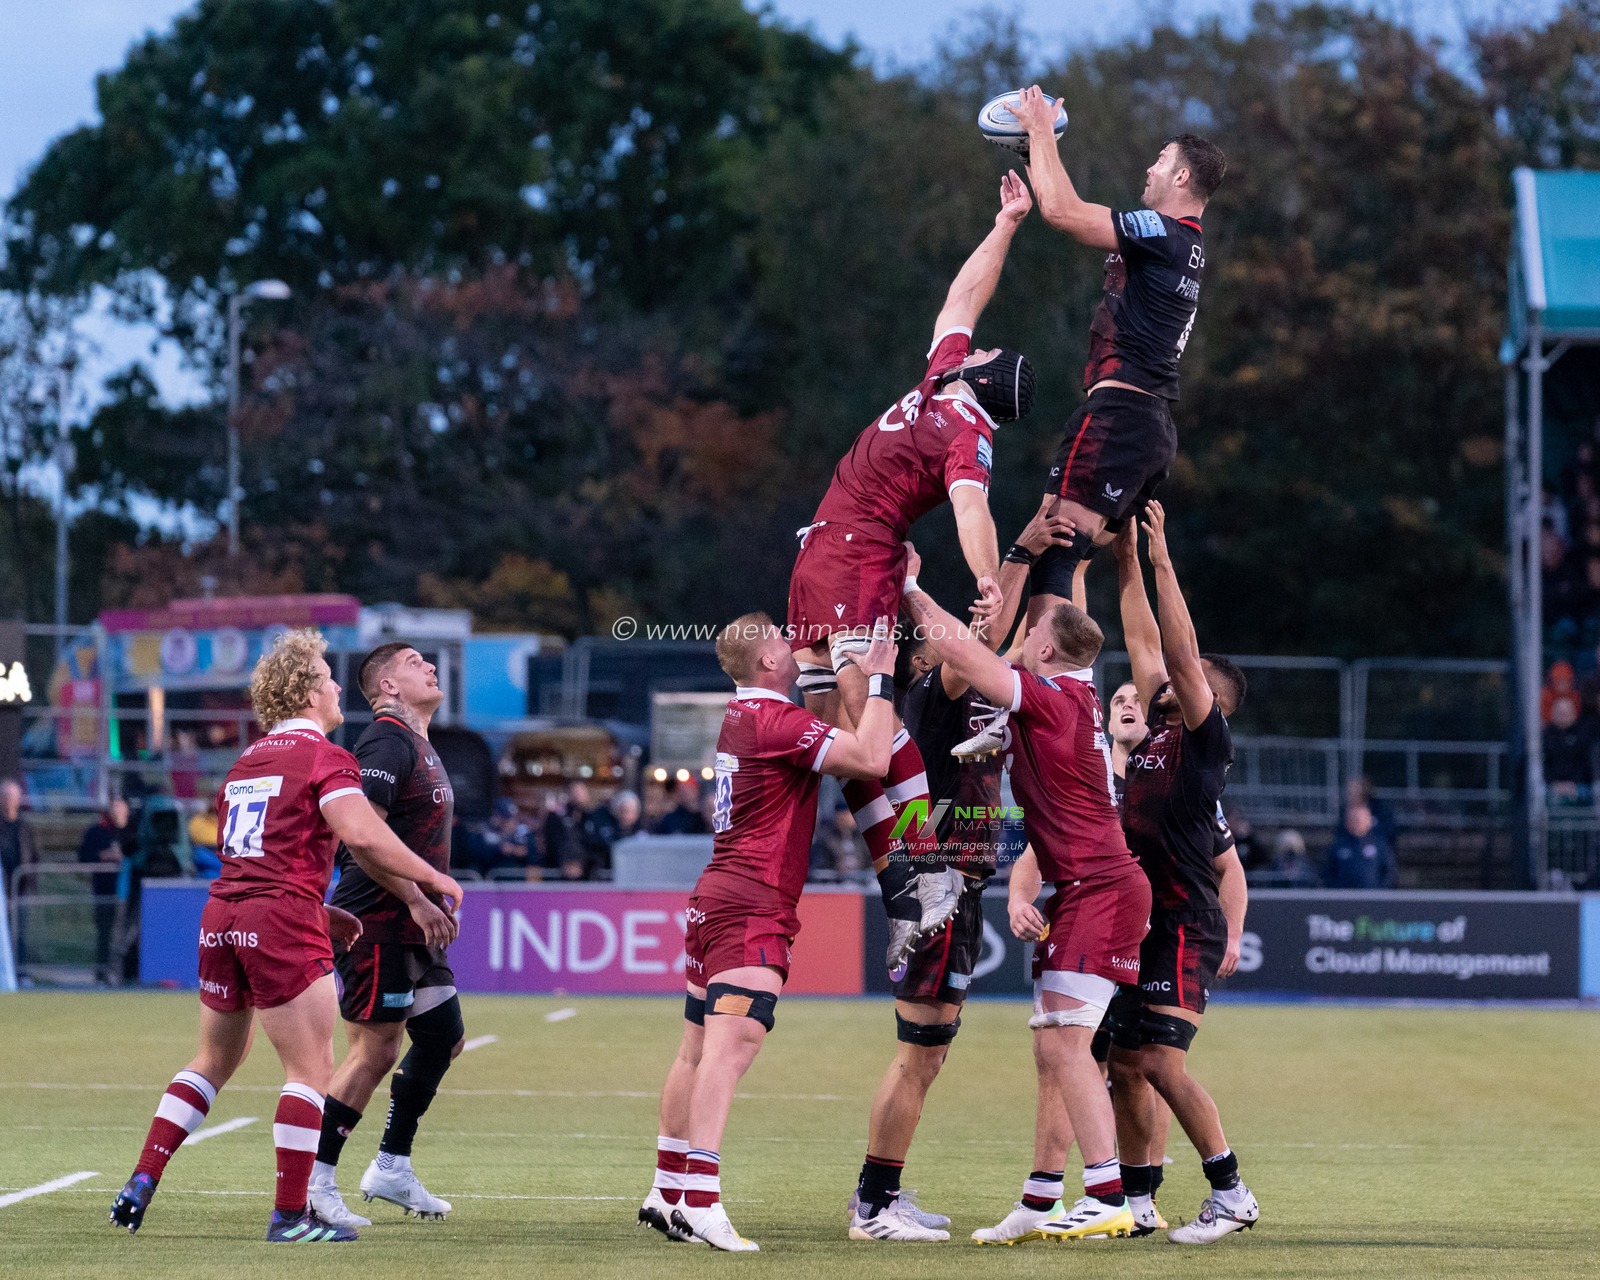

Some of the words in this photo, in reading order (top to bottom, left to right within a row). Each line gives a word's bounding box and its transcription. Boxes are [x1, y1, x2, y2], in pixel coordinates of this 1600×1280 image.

[229, 785, 254, 796] Roma
[360, 768, 396, 784] cronis
[224, 801, 267, 859] 17
[489, 908, 687, 975] INDE
[1306, 914, 1354, 941] The
[1355, 914, 1435, 941] Future
[1436, 914, 1467, 941] of
[1305, 946, 1382, 974] Cloud
[1384, 948, 1550, 980] Management
